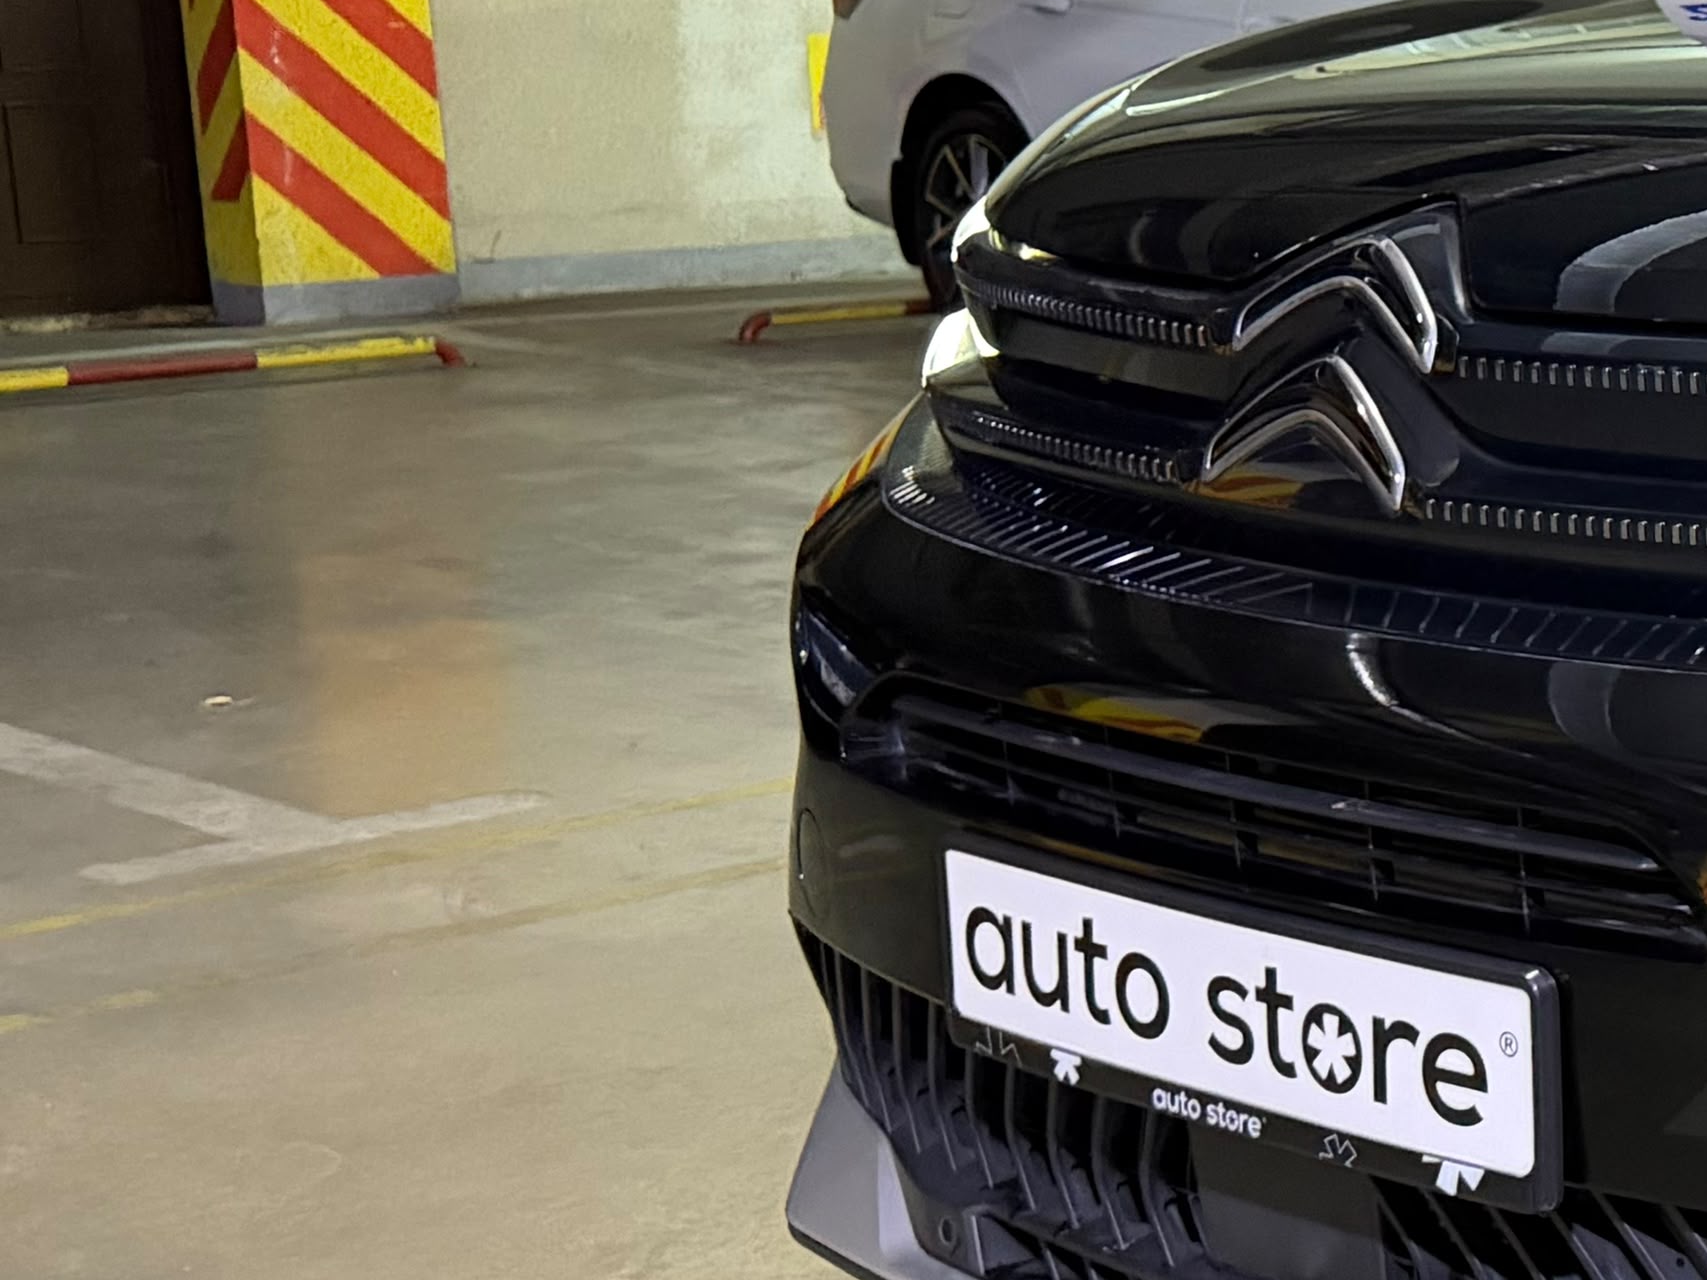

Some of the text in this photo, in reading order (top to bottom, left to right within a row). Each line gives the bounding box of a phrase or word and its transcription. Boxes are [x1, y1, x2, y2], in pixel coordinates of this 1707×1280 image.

[965, 905, 1171, 1040] auto
[1152, 1087, 1262, 1138] auto store
